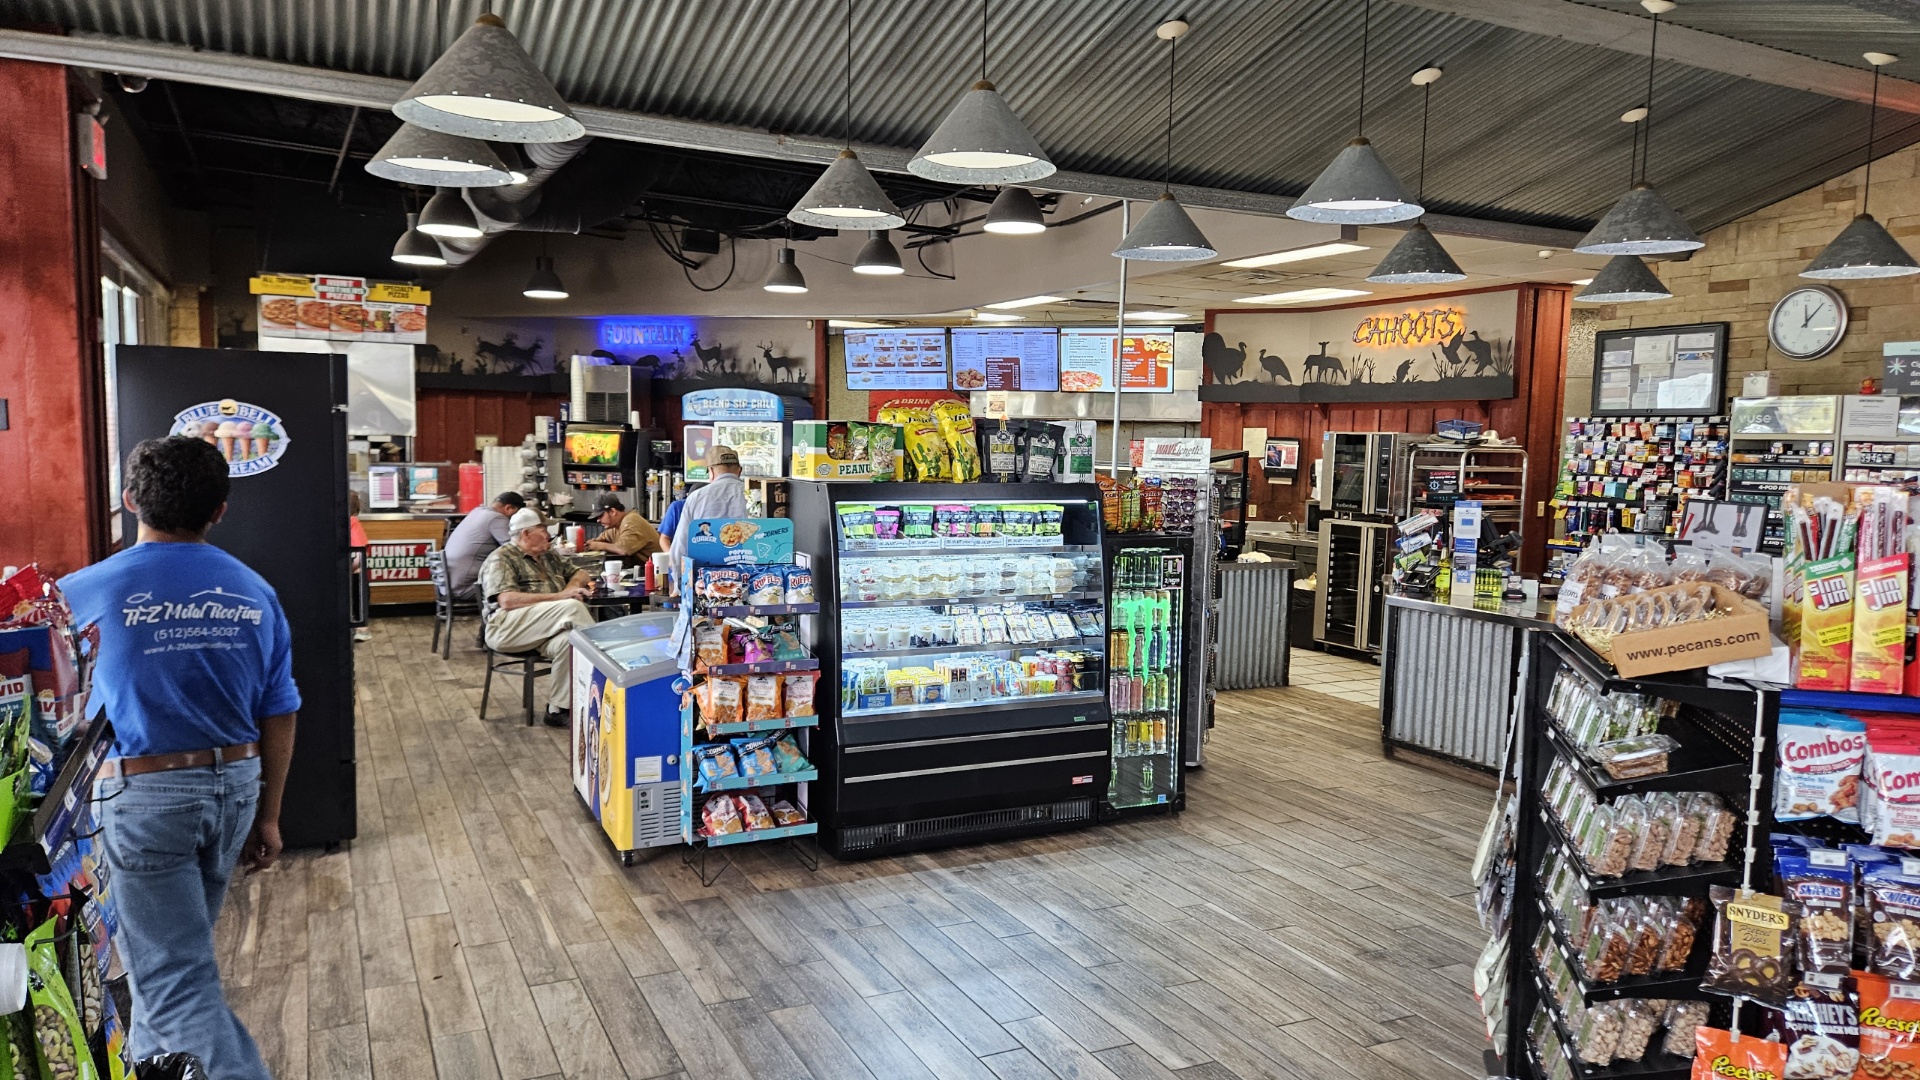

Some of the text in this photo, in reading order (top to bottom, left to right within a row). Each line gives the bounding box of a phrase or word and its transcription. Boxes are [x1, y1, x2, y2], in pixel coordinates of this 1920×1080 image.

[1352, 307, 1457, 345] CAHOOTS
[603, 323, 684, 345] FOUNTAIN
[703, 399, 776, 409] BLEND SIP CHILL
[182, 403, 276, 426] BLUE BELL
[1740, 415, 1771, 424] vuse
[229, 455, 273, 476] REAM
[839, 464, 870, 475] PEANU
[691, 536, 717, 544] QUAKER
[754, 526, 789, 541] POPCORNERS
[370, 545, 417, 557] HUNT
[366, 557, 432, 568] ROTHERS
[1862, 559, 1904, 573] ORIGINAL
[371, 568, 419, 580] PIZZA
[710, 570, 740, 581] RUFFLES
[754, 573, 783, 591] RUFFLES
[164, 601, 206, 621] Metal
[203, 601, 263, 626] Roofing
[1627, 630, 1761, 662] www.pecans.com
[0, 681, 25, 697] VID
[1785, 733, 1865, 762] Combos
[1798, 782, 1825, 790] Cheese
[1882, 770, 1920, 792] Com
[1887, 804, 1920, 813] Peppero
[1896, 812, 1918, 820] Pizza
[1799, 884, 1841, 898] SNICKERS
[1880, 890, 1920, 907] SNICKE
[1729, 905, 1785, 925] SNYDER'S
[1738, 925, 1772, 937] Pretzel
[1743, 932, 1767, 945] Dips
[1786, 1001, 1858, 1026] HERHEY'S
[1859, 1007, 1920, 1034] Reese'
[1785, 1021, 1817, 1032] POPPE
